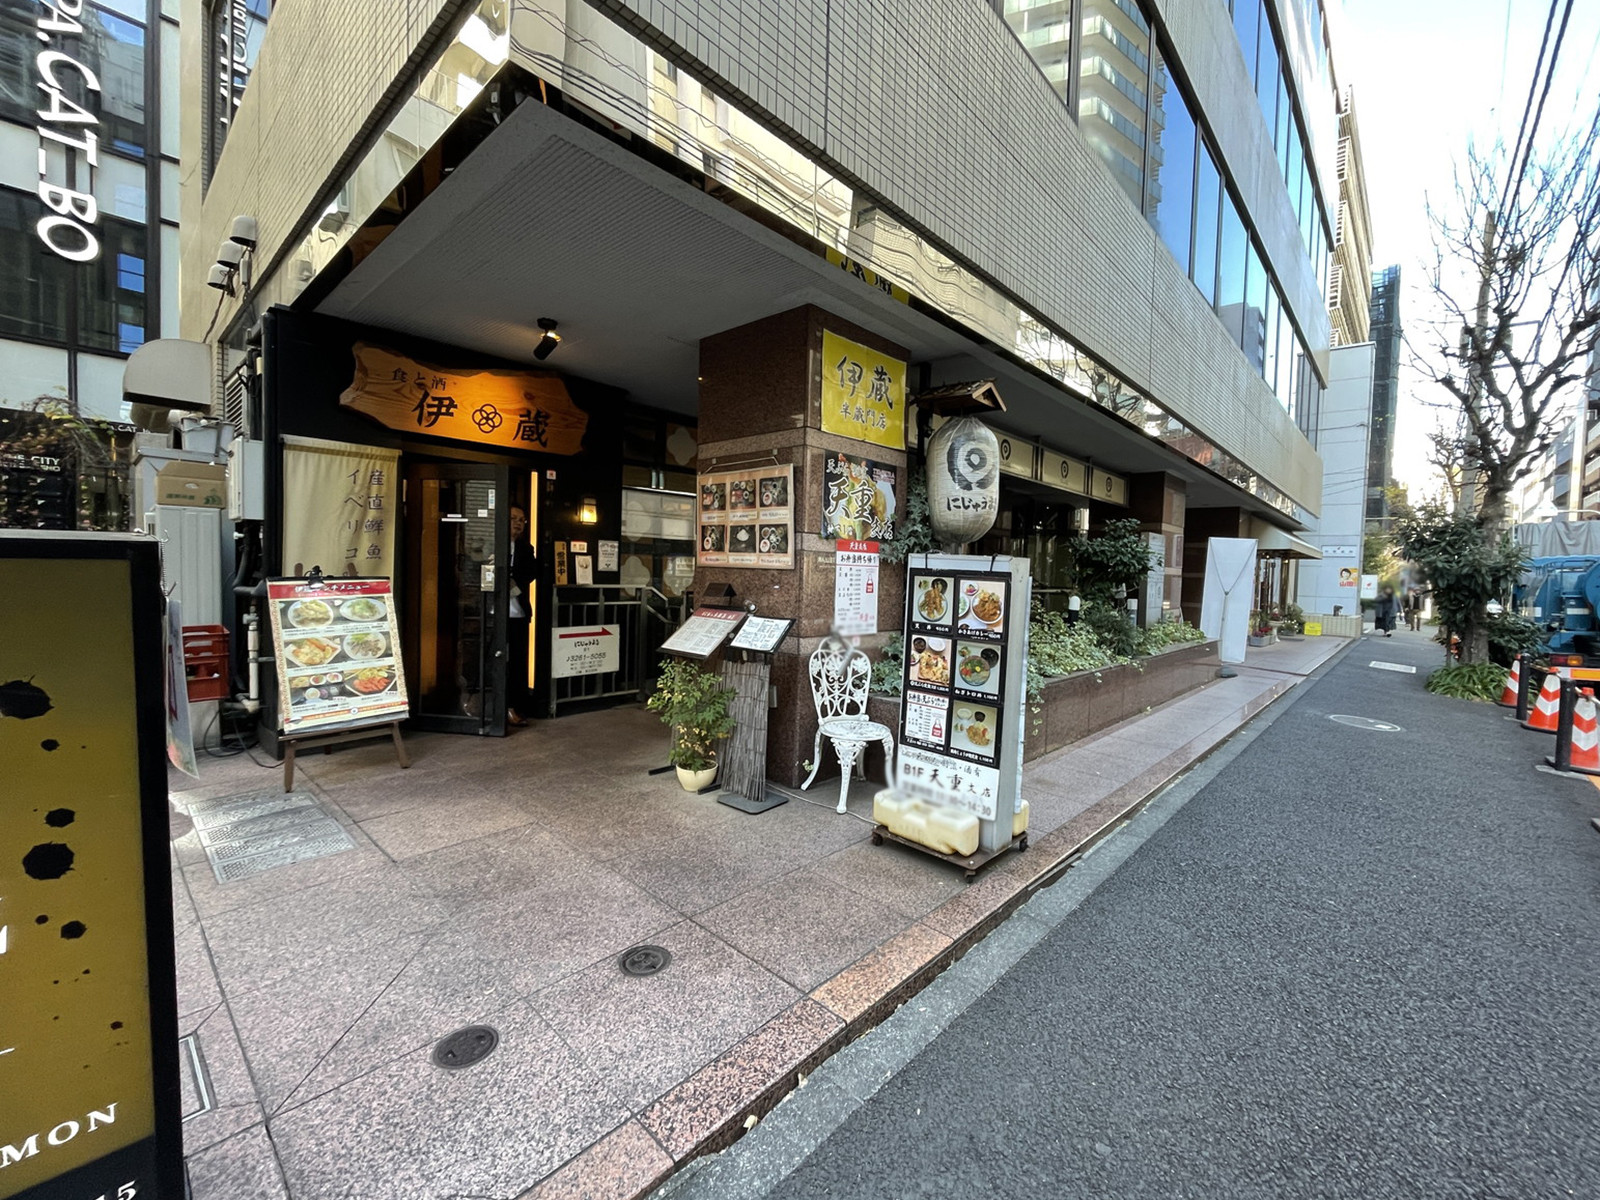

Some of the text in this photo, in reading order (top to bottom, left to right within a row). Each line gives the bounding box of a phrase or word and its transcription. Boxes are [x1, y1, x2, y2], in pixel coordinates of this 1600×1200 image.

[836, 355, 894, 410] 伊蔵
[344, 469, 363, 559] イベリコ
[364, 469, 384, 560] 産直鮮魚
[904, 763, 924, 778] B1F
